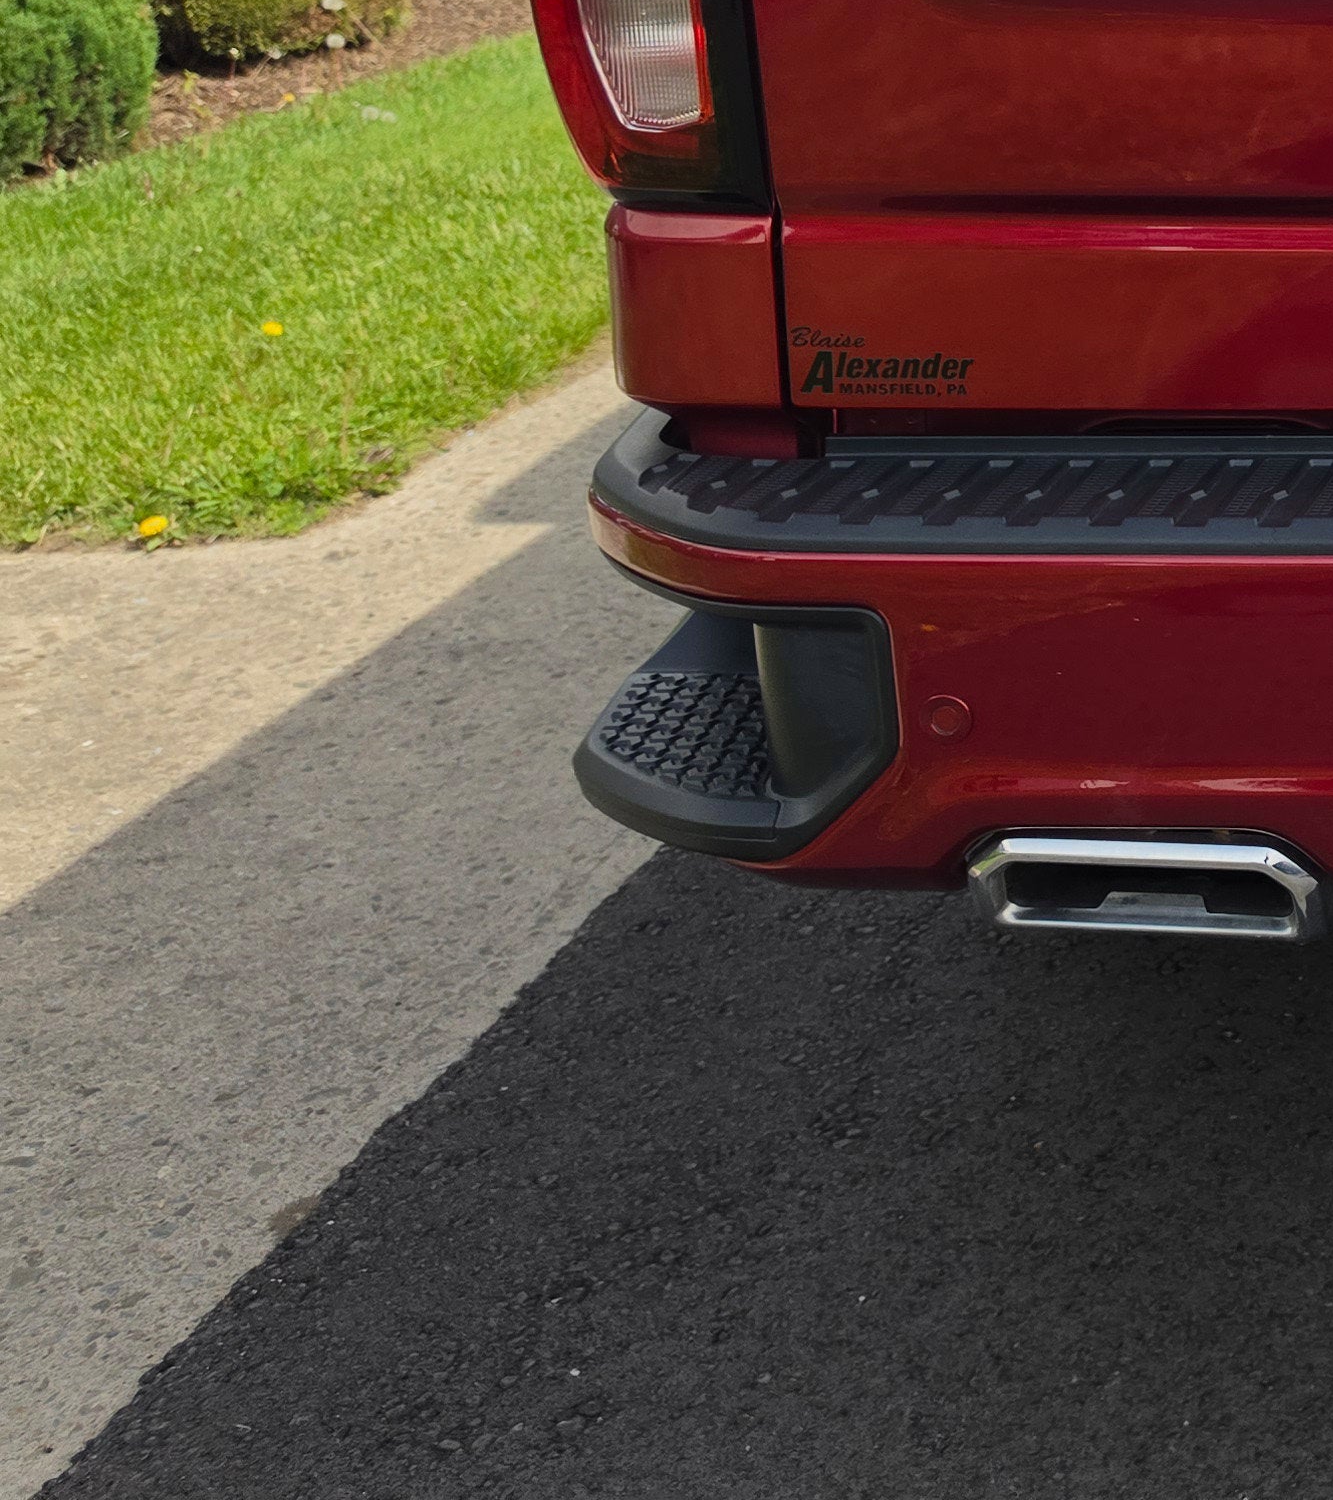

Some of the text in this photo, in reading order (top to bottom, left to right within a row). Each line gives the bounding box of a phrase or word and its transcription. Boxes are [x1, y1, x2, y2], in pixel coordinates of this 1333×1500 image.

[790, 326, 866, 348] Blaise
[801, 350, 975, 394] Alexander
[946, 382, 968, 396] PA
